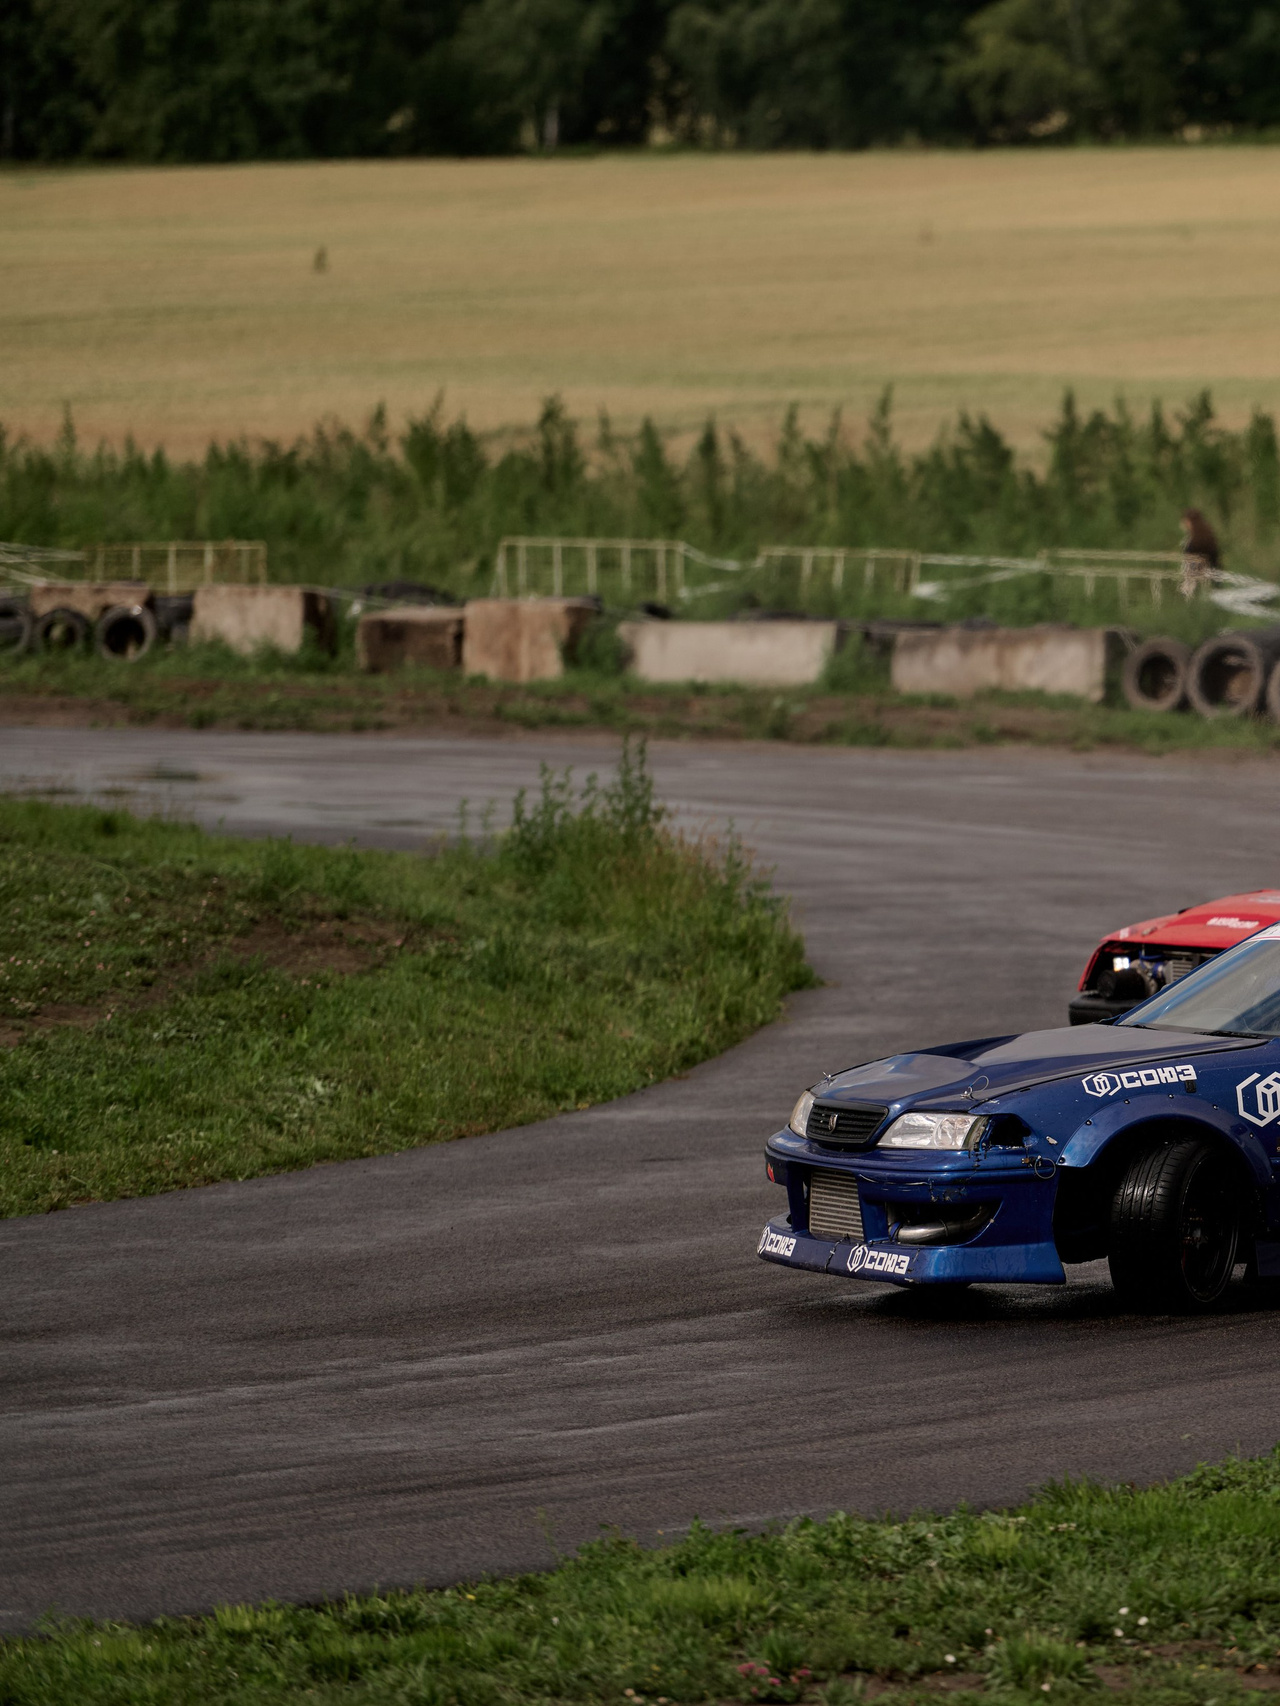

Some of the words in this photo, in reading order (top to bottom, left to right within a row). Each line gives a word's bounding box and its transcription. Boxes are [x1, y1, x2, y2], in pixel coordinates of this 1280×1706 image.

[1120, 1064, 1197, 1089] СОЮЗ
[765, 1232, 797, 1257] СОЮЗ
[864, 1250, 911, 1275] СОЮЗ
